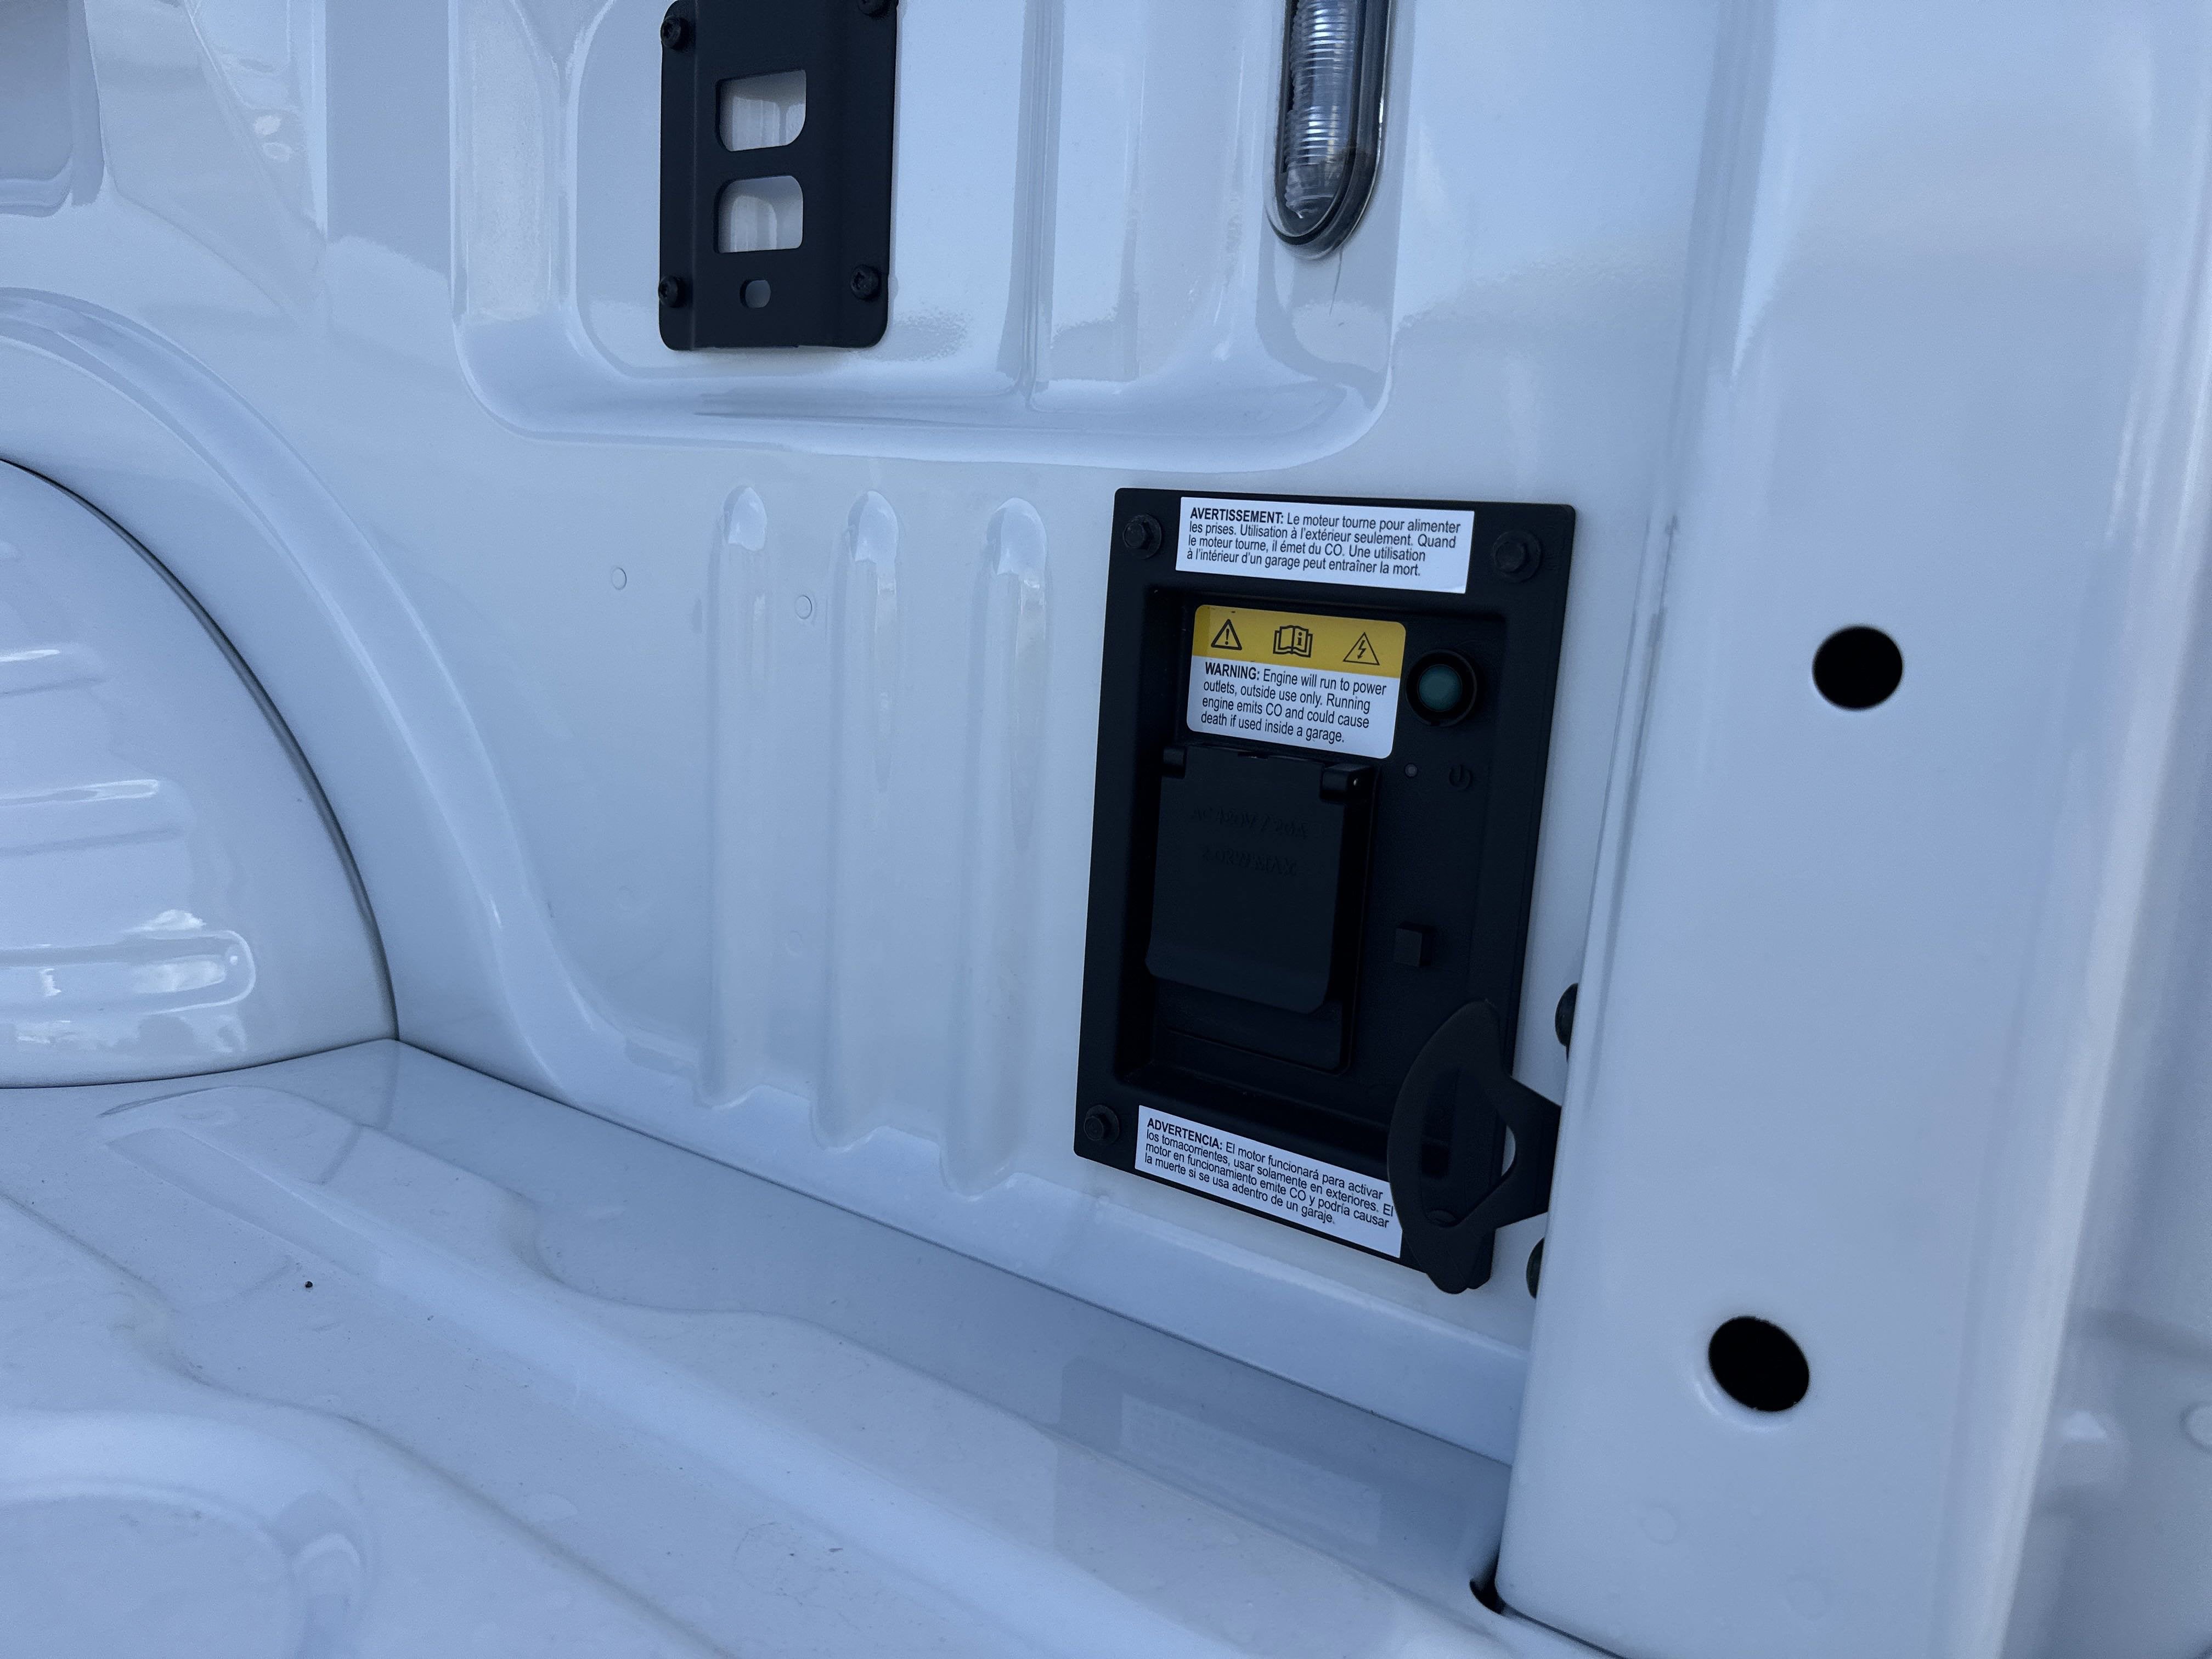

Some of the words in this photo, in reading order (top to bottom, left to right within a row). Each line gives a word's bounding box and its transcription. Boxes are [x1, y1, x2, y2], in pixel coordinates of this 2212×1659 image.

[1189, 521, 1203, 533] les
[1206, 522, 1236, 536] prises.
[1240, 524, 1287, 538] Utilisation
[1291, 527, 1297, 539] à
[1354, 531, 1413, 545] seulement.
[1418, 534, 1456, 548] Quand
[1190, 507, 1283, 524] AVERTISSEMENT:
[1287, 512, 1299, 525] Le
[1303, 515, 1339, 527] moteur
[1342, 516, 1376, 529] tourne
[1379, 520, 1404, 532] pour
[1408, 519, 1460, 533] alimenter
[1187, 548, 1193, 559] à
[1265, 556, 1300, 570] garage
[1303, 558, 1326, 571] peut
[1329, 560, 1377, 573] entraîner
[1380, 561, 1389, 574] la
[1393, 564, 1420, 576] mort.
[1188, 534, 1196, 546] le
[1199, 537, 1233, 549] moteur
[1235, 538, 1268, 553] tourne,
[1272, 540, 1277, 551] il
[1280, 540, 1306, 554] émet
[1308, 543, 1321, 555] du
[1325, 543, 1344, 556] CO.
[1349, 544, 1370, 558] Une
[1374, 547, 1425, 561] utilisation
[1205, 662, 1260, 680] WARNING:
[1263, 669, 1297, 686] Engine
[1301, 674, 1317, 687] will
[1320, 678, 1336, 690] run
[1340, 678, 1350, 691] to
[1353, 682, 1386, 695] power
[1203, 697, 1233, 712] engine
[1237, 701, 1262, 714] emits
[1266, 703, 1282, 716] CO
[1285, 707, 1304, 720] and
[1307, 710, 1335, 724] could
[1338, 715, 1369, 728] cause
[1204, 680, 1237, 697] outlets,
[1241, 685, 1276, 699] outside
[1279, 691, 1296, 702] use
[1300, 691, 1322, 708] only.
[1327, 693, 1370, 714] Running
[1201, 711, 1227, 726] death
[1230, 714, 1237, 727] if
[1239, 719, 1262, 731] used
[1265, 719, 1294, 735] inside
[1297, 727, 1302, 736] a
[1306, 728, 1344, 744] garage.
[1147, 1118, 1222, 1150] ADVERTENCIA:
[1226, 1142, 1235, 1154] El
[1238, 1148, 1266, 1163] motor
[1268, 1155, 1319, 1180] funcionará
[1322, 1174, 1345, 1188] para
[1348, 1182, 1383, 1199] activar
[1147, 1129, 1159, 1142] los
[1162, 1135, 1229, 1166] tomacorrientes,
[1234, 1159, 1255, 1172] usar
[1257, 1166, 1307, 1189] solamente
[1310, 1183, 1322, 1194] en
[1326, 1188, 1379, 1212] exteriores.
[1383, 1204, 1393, 1217] El
[1145, 1152, 1152, 1164] la
[1155, 1158, 1186, 1175] muerte
[1189, 1168, 1196, 1178] si
[1199, 1172, 1209, 1182] se
[1213, 1177, 1229, 1189] usa
[1232, 1183, 1268, 1201] adentro
[1271, 1194, 1283, 1206] de
[1286, 1201, 1298, 1211] un
[1301, 1206, 1334, 1224] garaje.
[1146, 1143, 1171, 1158] motor
[1173, 1153, 1184, 1163] en
[1188, 1154, 1257, 1185] funcionamiento
[1260, 1180, 1286, 1195] emite
[1290, 1187, 1306, 1201] CO
[1309, 1195, 1315, 1206] y
[1318, 1199, 1350, 1216] podría
[1353, 1210, 1389, 1228] causar
